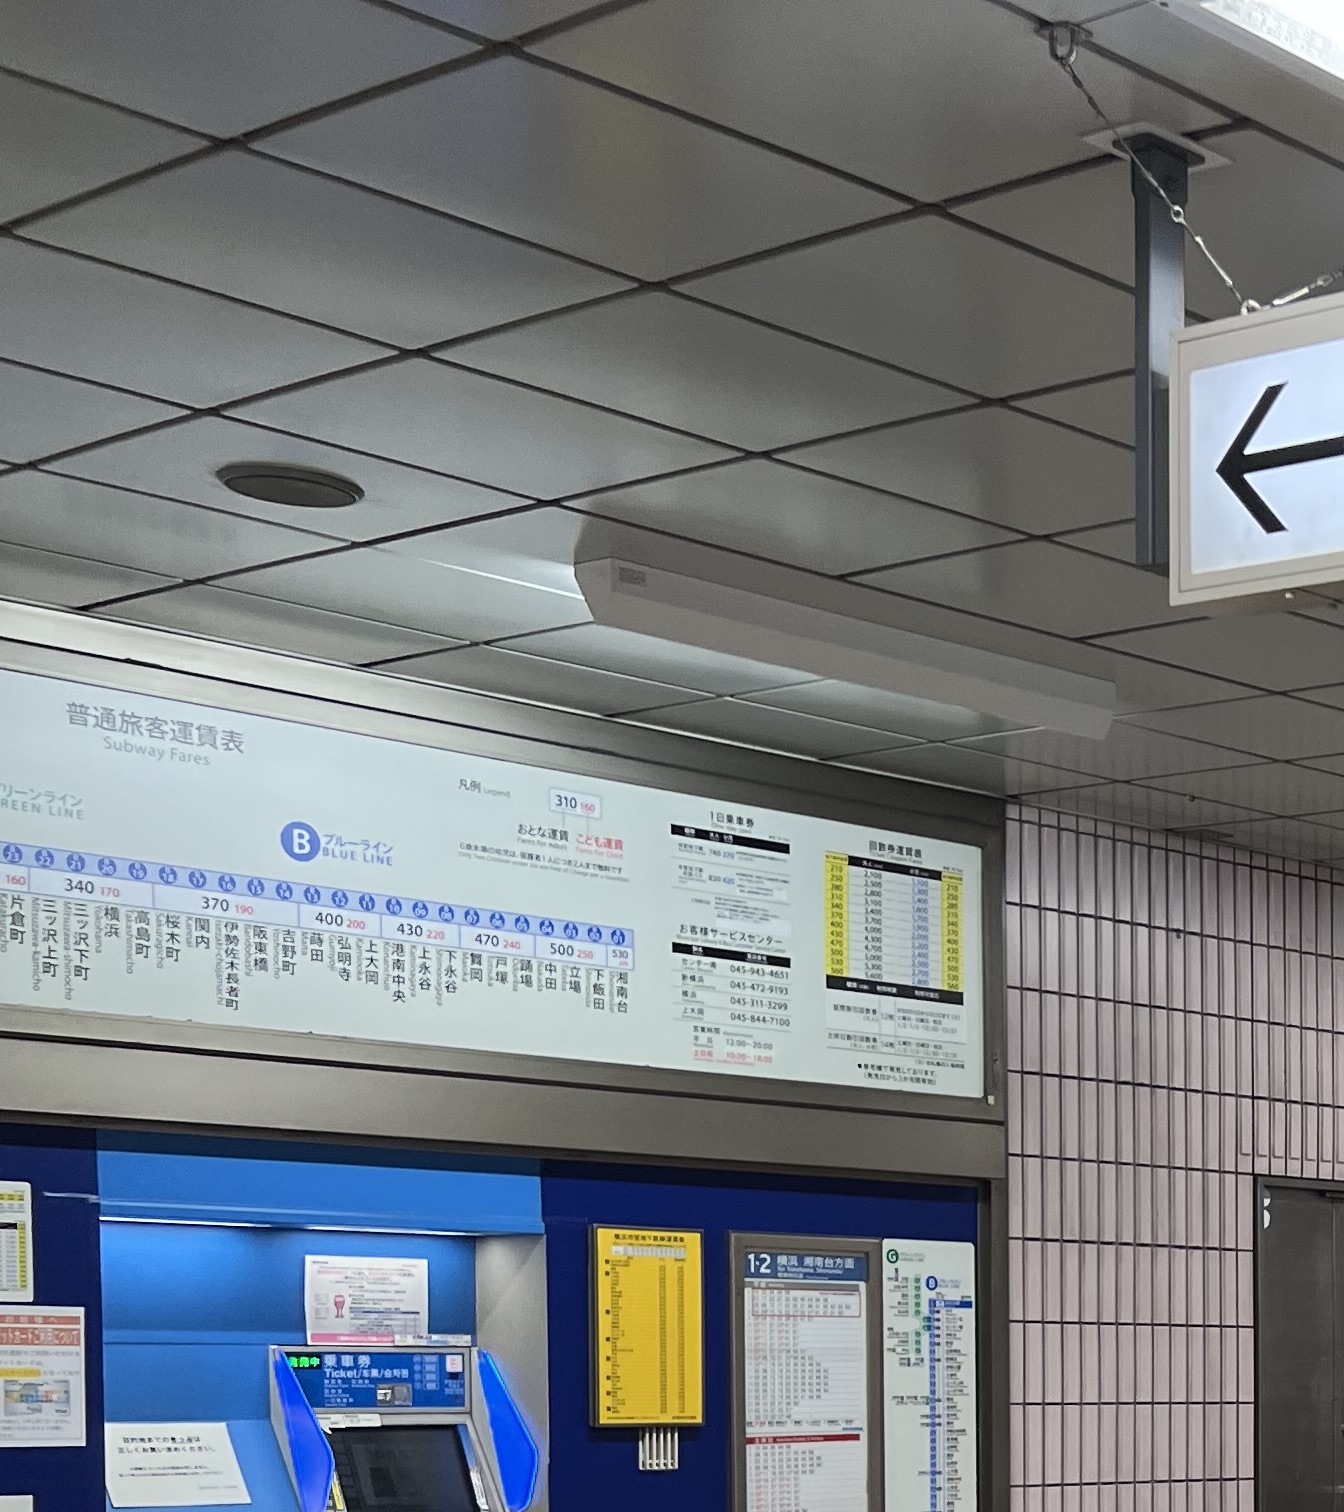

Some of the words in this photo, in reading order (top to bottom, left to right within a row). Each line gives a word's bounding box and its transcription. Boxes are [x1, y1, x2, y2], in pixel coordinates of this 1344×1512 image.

[66, 701, 245, 754] 普通旅客運賃表
[103, 736, 165, 761] Subway
[170, 747, 210, 766] Fares
[48, 802, 84, 820] LINE
[555, 794, 577, 809] 310
[292, 829, 311, 855] B
[323, 833, 393, 854] ブルーライン
[517, 823, 569, 842] おとな運賃
[576, 833, 624, 850] こども運賃
[322, 847, 359, 861] BLUE
[363, 853, 392, 866] LINE
[5, 874, 26, 886] 160
[64, 878, 95, 894] 340
[100, 886, 120, 898] 170
[201, 897, 229, 912] 370
[234, 904, 254, 915] 190
[315, 912, 343, 926] 400
[346, 919, 366, 929] 200
[397, 923, 423, 937] 430
[426, 930, 445, 940] 220
[475, 933, 499, 947] 470
[550, 942, 574, 957] 500
[104, 905, 120, 938] 横浜
[134, 910, 152, 959] 高島町
[165, 913, 181, 962] 桜木町
[281, 928, 298, 976] 吉野町
[365, 940, 379, 985] 上大岡
[545, 962, 557, 990] 中田
[730, 965, 789, 980] 045-943-4651
[730, 981, 788, 996] 045-472-9193
[730, 997, 788, 1011] 045-311-3299
[730, 1012, 790, 1027] 045-844-7100
